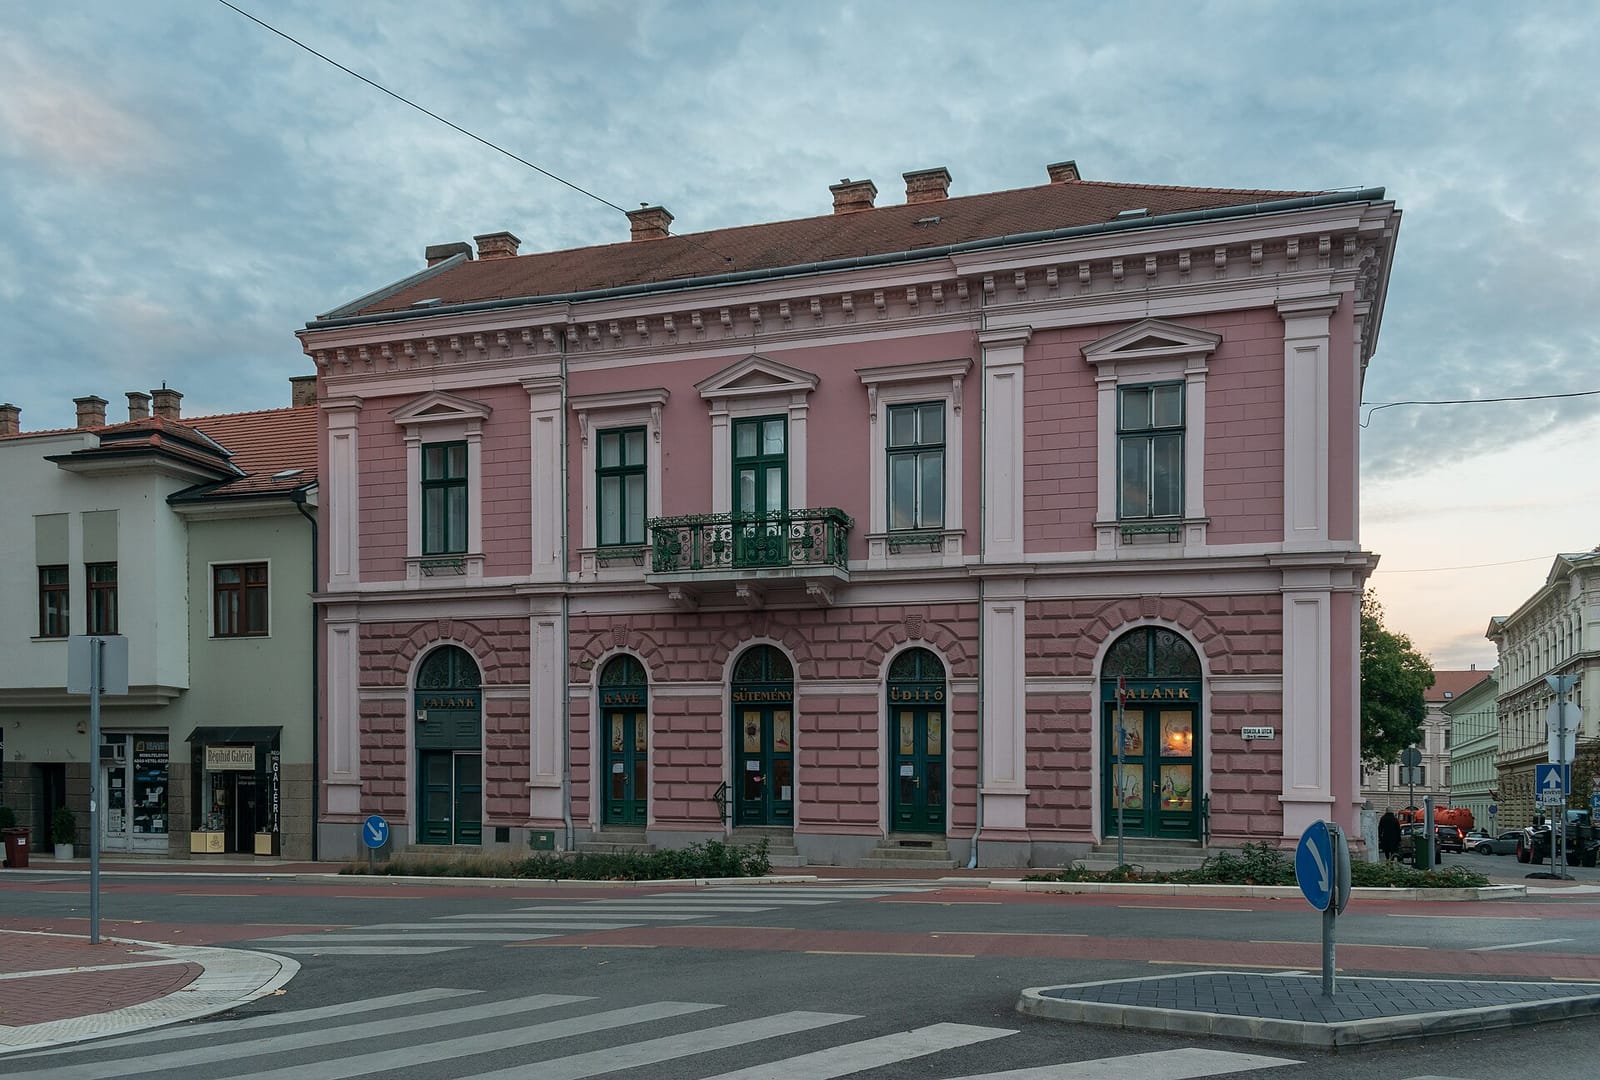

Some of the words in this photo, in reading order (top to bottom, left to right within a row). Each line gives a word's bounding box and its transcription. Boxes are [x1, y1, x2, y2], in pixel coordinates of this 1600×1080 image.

[604, 690, 640, 704] KÁVÉ
[732, 687, 793, 702] SÜTEMÉNY
[272, 762, 280, 833] GALÉRIA
